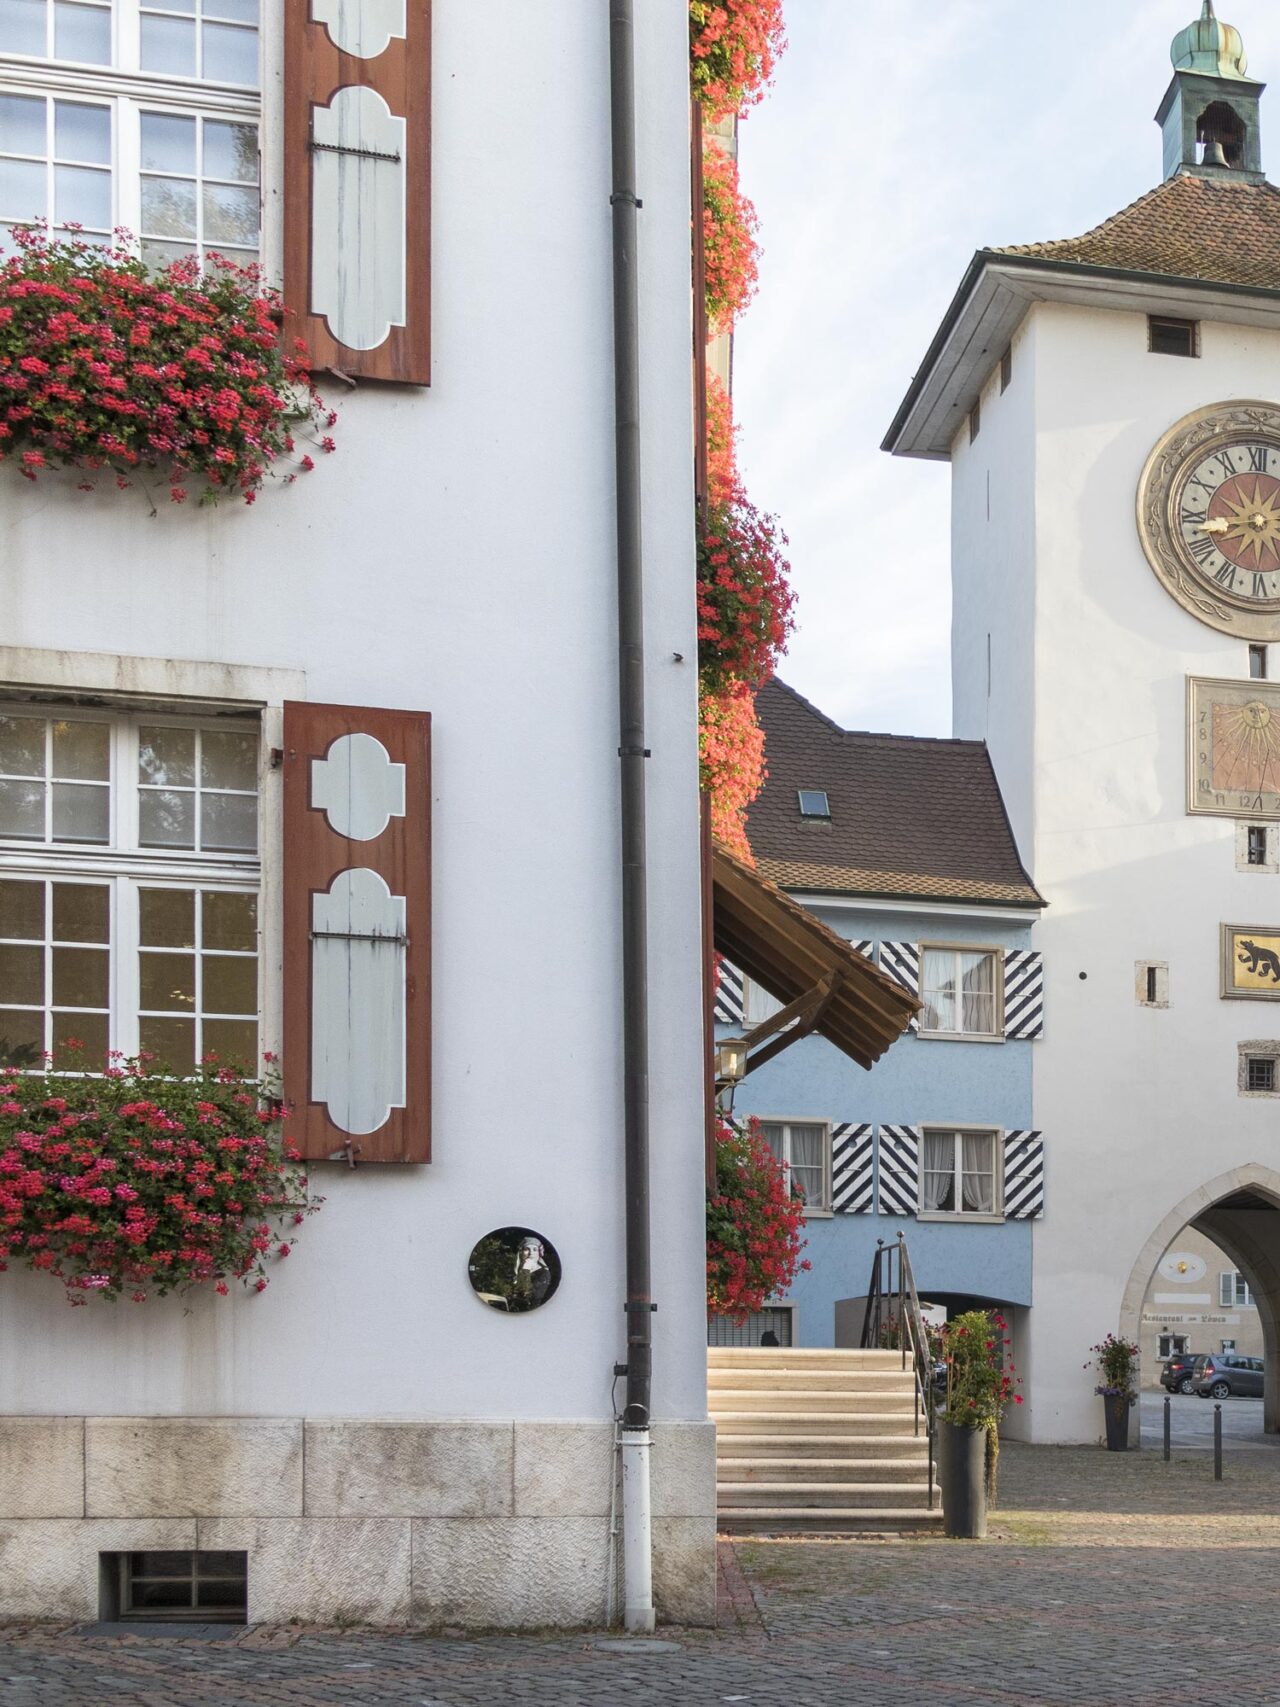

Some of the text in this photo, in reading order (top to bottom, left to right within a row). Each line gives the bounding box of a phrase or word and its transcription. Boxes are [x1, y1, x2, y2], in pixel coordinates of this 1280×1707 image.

[1214, 451, 1237, 478] XI
[1247, 447, 1267, 472] XII
[1191, 474, 1216, 496] X
[1182, 509, 1206, 523] IX
[1188, 537, 1215, 566] VIII
[1214, 559, 1236, 588] VII
[1251, 573, 1267, 597] VI
[1200, 712, 1207, 722] 7
[1199, 729, 1207, 740] 8
[1200, 753, 1207, 764] 9
[1198, 779, 1210, 791] 10
[1215, 795, 1225, 805] 11
[1240, 797, 1249, 808] 12
[1275, 798, 1280, 809] 2
